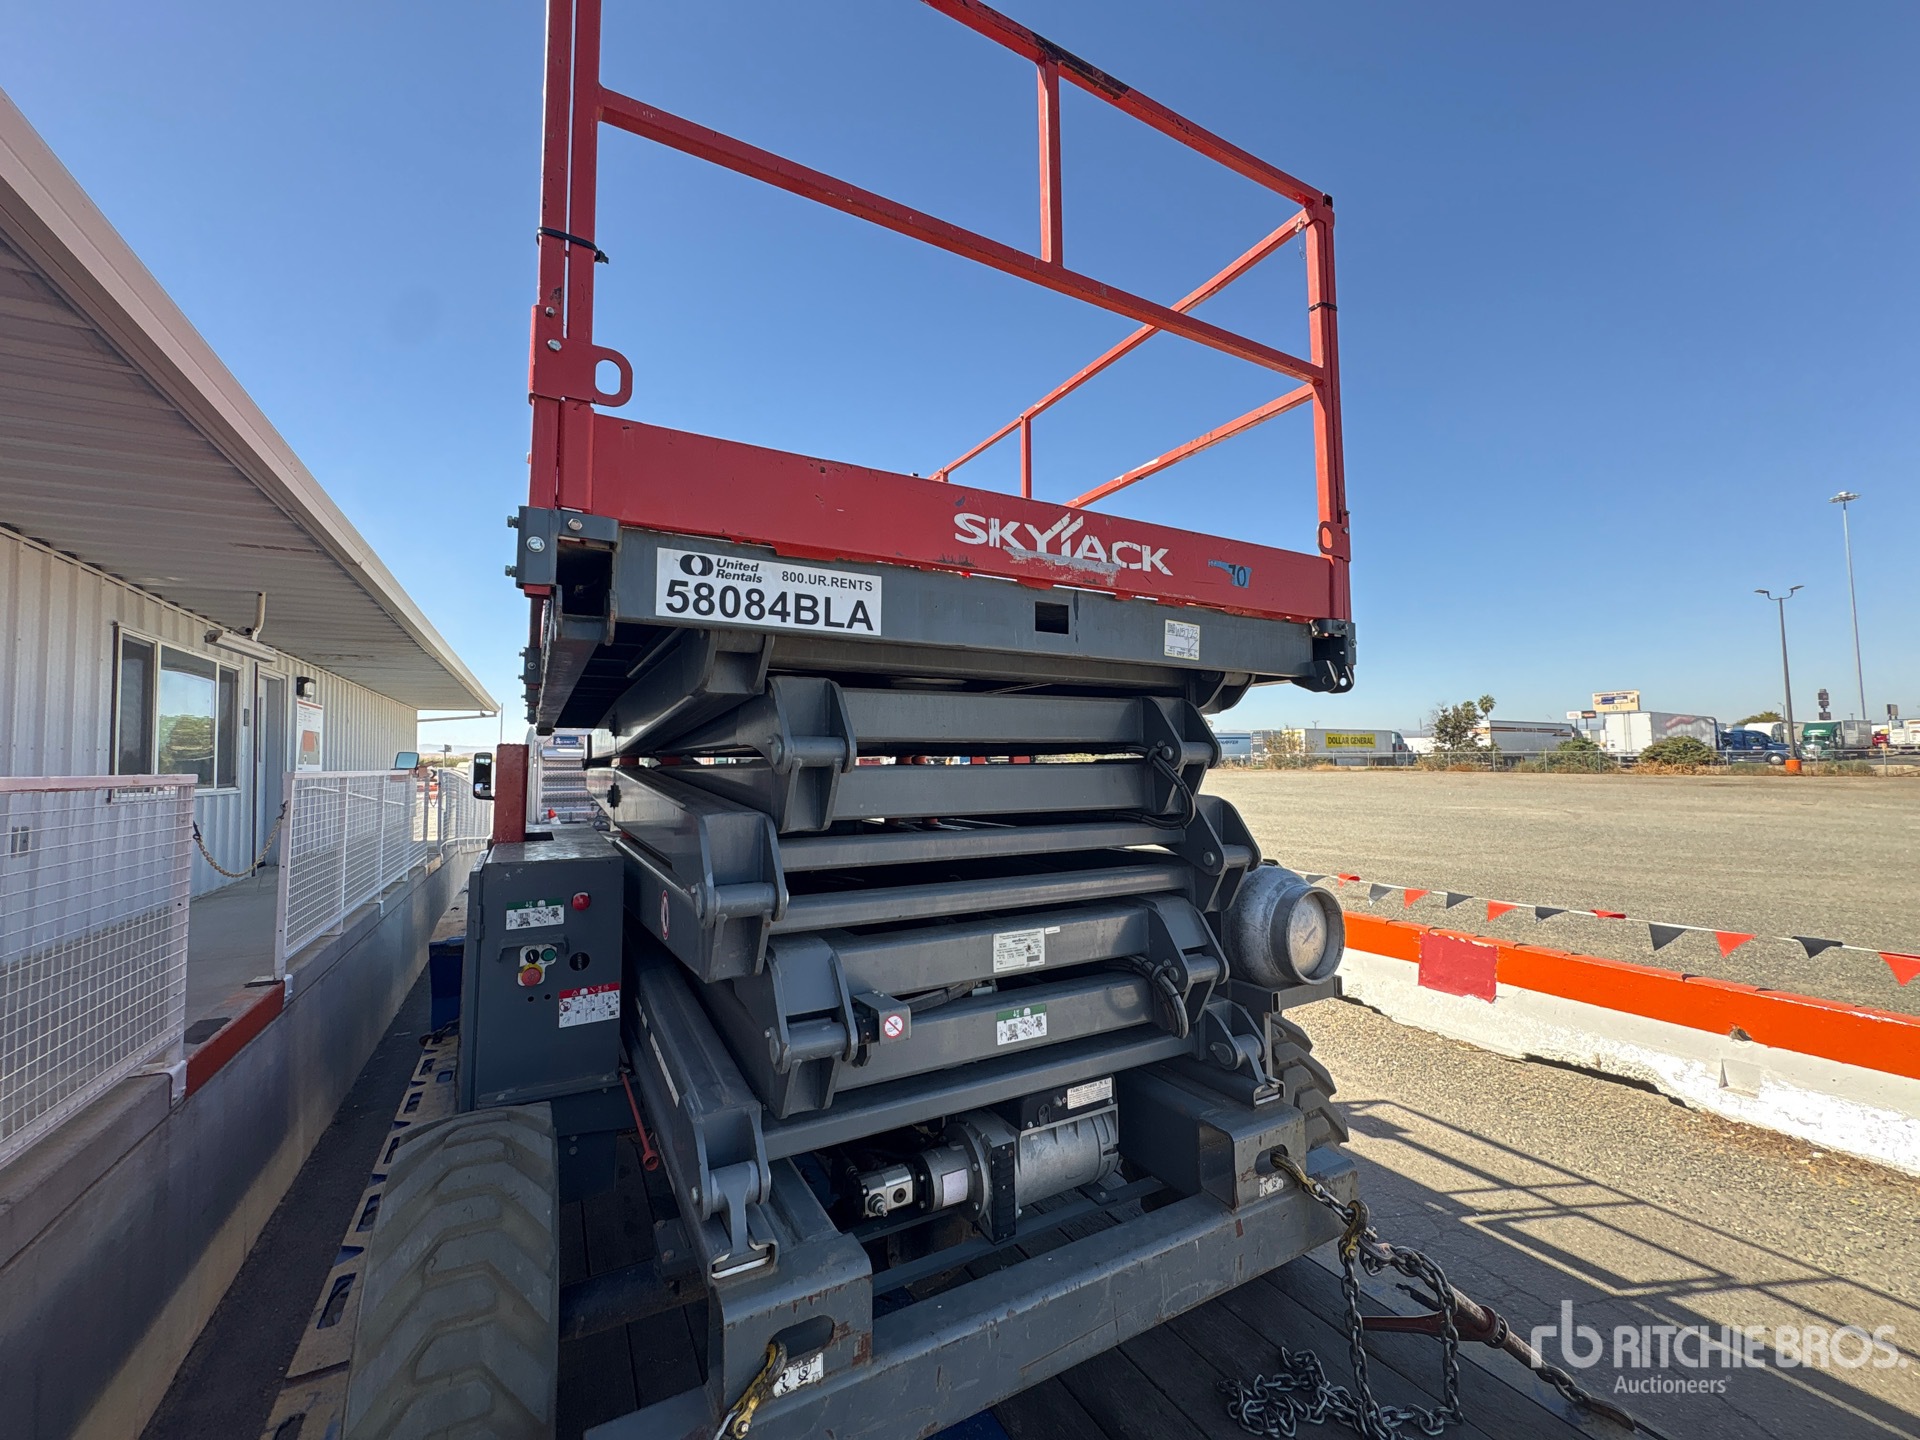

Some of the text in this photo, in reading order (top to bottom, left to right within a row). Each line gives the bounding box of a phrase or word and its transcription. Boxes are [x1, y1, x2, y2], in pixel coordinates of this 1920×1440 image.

[953, 511, 1174, 577] SKYJACK
[716, 557, 760, 573] United
[715, 567, 763, 584] Rentals
[781, 570, 873, 593] 800.UR.RENTS
[665, 579, 875, 632] 58084BLA
[1327, 736, 1374, 745] DOLLAR GENERAL
